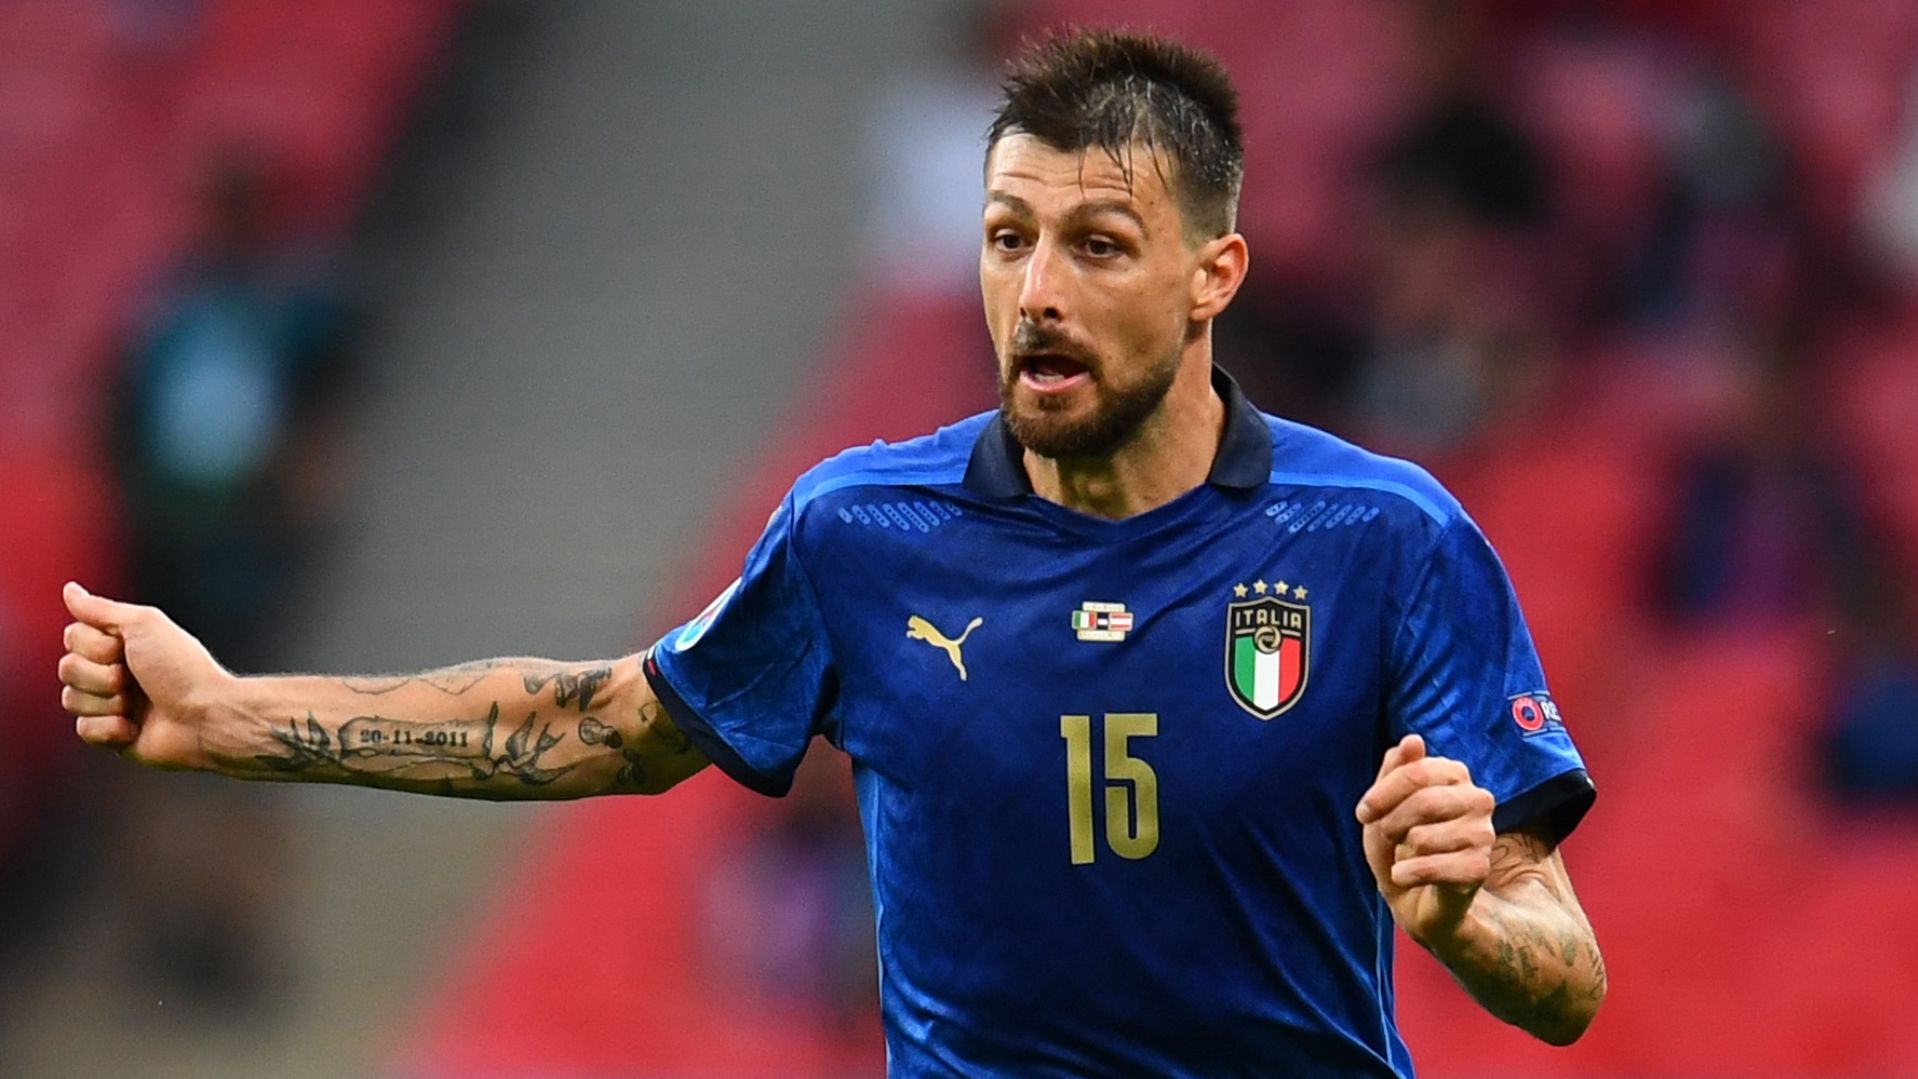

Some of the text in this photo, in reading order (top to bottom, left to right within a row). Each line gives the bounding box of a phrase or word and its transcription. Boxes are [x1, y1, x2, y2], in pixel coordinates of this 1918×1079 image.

[1235, 609, 1302, 629] ITALIA
[360, 729, 468, 747] 20-11-2011
[1060, 713, 1159, 865] 15
